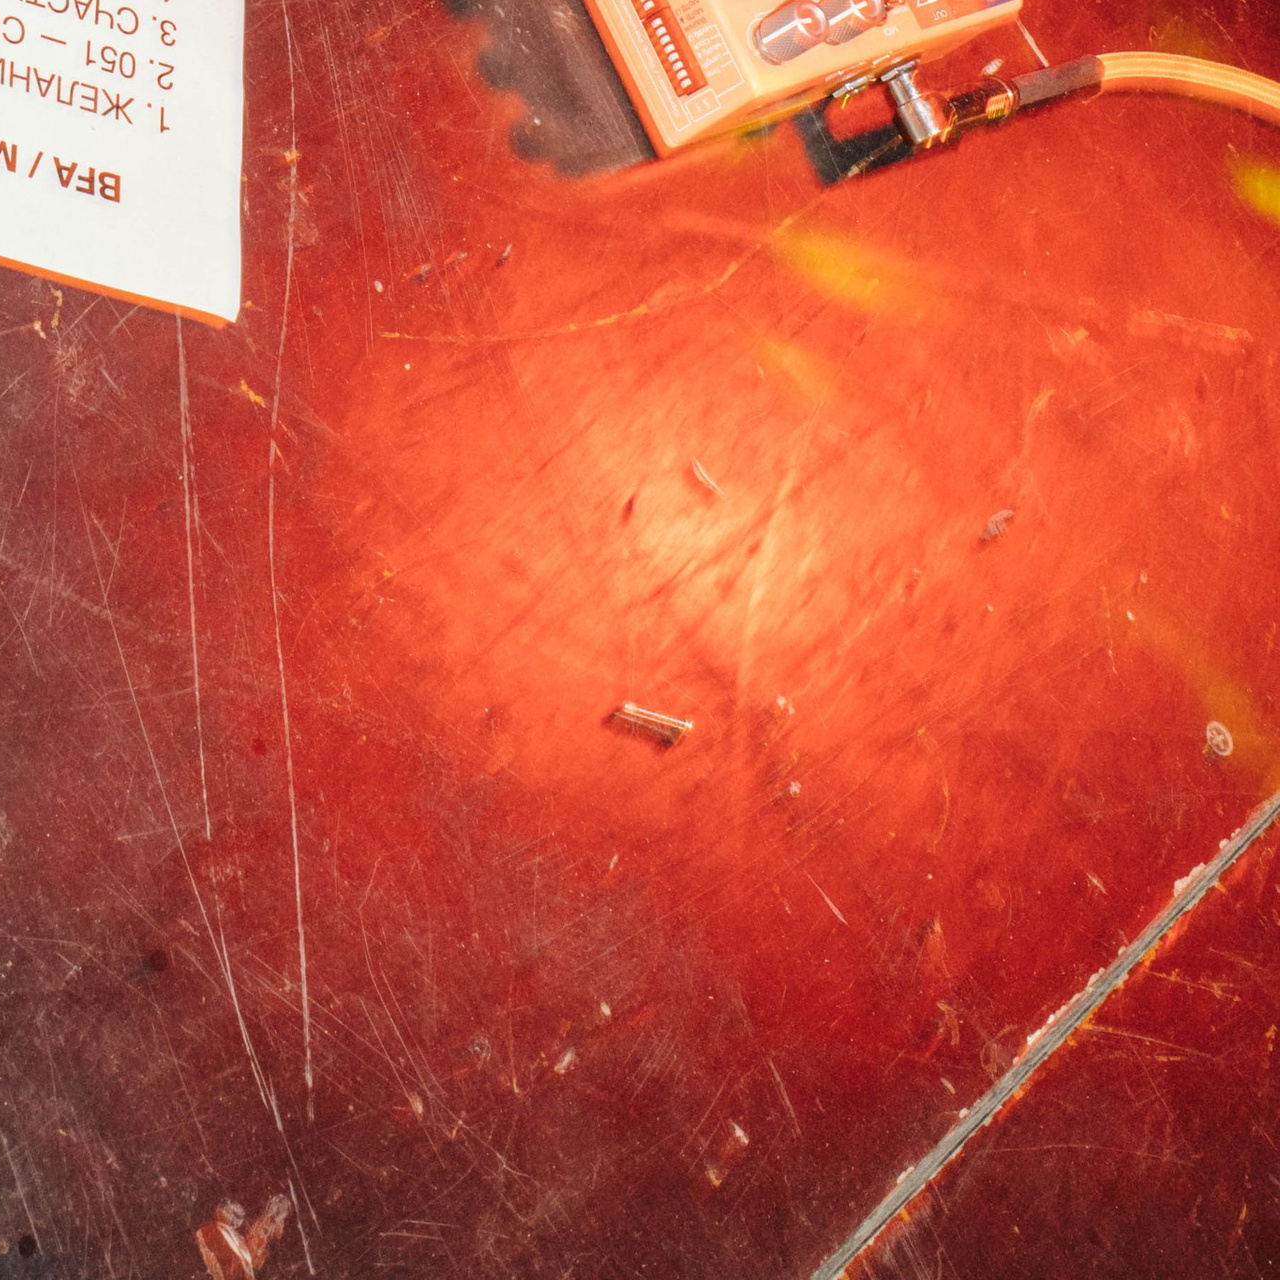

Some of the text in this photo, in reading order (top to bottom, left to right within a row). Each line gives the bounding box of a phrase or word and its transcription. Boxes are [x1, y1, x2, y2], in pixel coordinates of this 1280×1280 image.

[153, 16, 176, 46] 3.
[86, 40, 136, 78] 051
[150, 60, 174, 90] 2.
[148, 103, 170, 133] 1.
[28, 152, 43, 178] /
[53, 157, 120, 203] BFA
